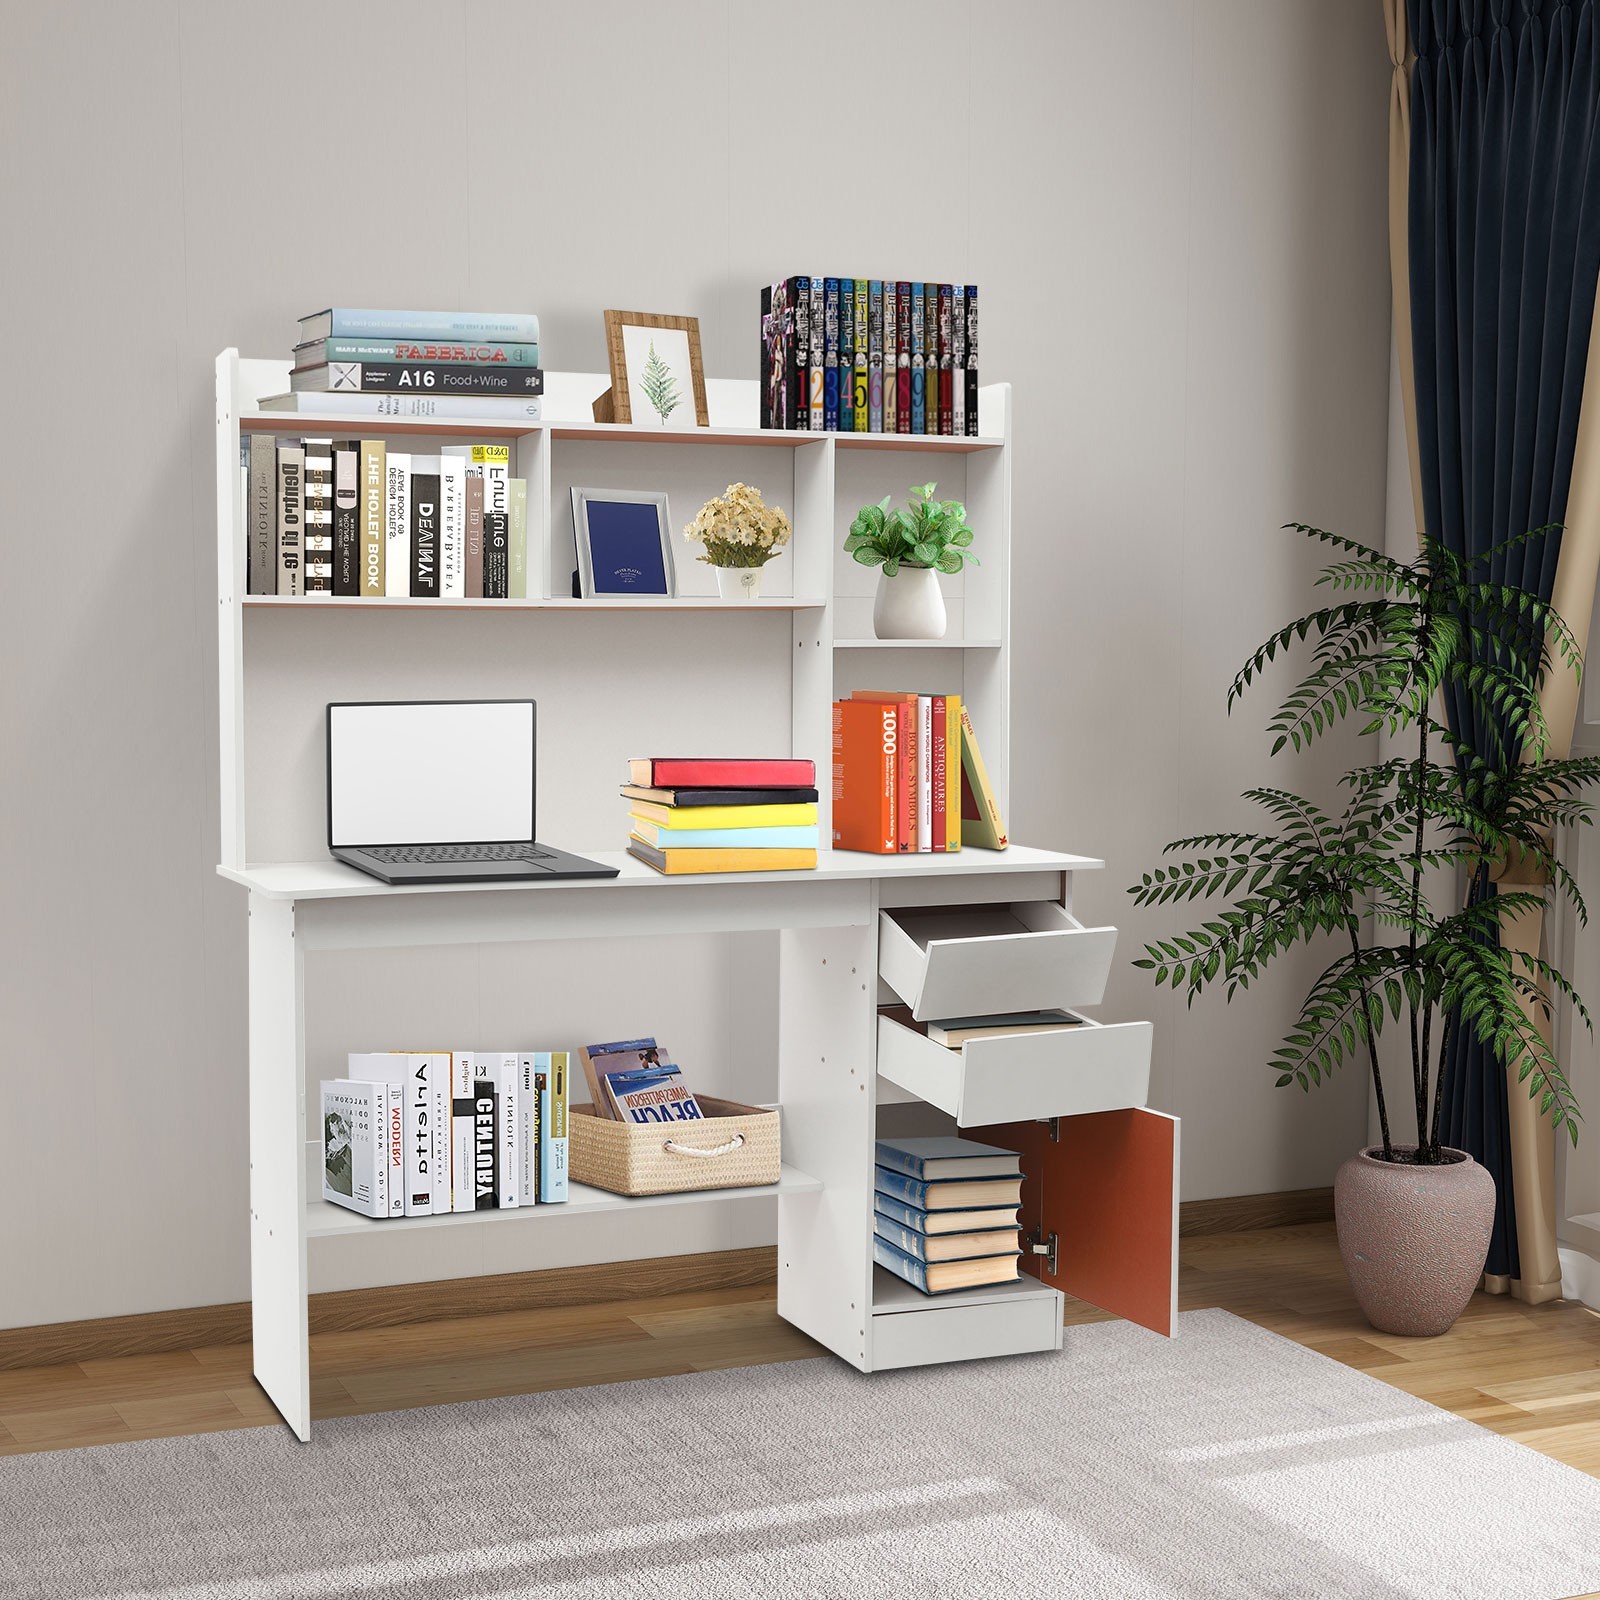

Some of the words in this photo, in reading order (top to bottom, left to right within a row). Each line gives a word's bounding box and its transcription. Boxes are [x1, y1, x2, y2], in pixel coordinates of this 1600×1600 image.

[398, 371, 435, 387] A16
[796, 370, 808, 408] 1
[811, 370, 824, 408] 2
[826, 370, 839, 408] 3
[841, 371, 853, 409] 4
[854, 372, 867, 408] 5
[869, 372, 882, 408] 6
[884, 372, 896, 408] 7
[898, 372, 910, 408] 8
[912, 372, 924, 408] 9
[883, 710, 897, 754] 1000
[908, 732, 917, 763] BOOK
[937, 736, 945, 813] ANTIQUAIRES
[908, 774, 917, 831] SYMBOLS
